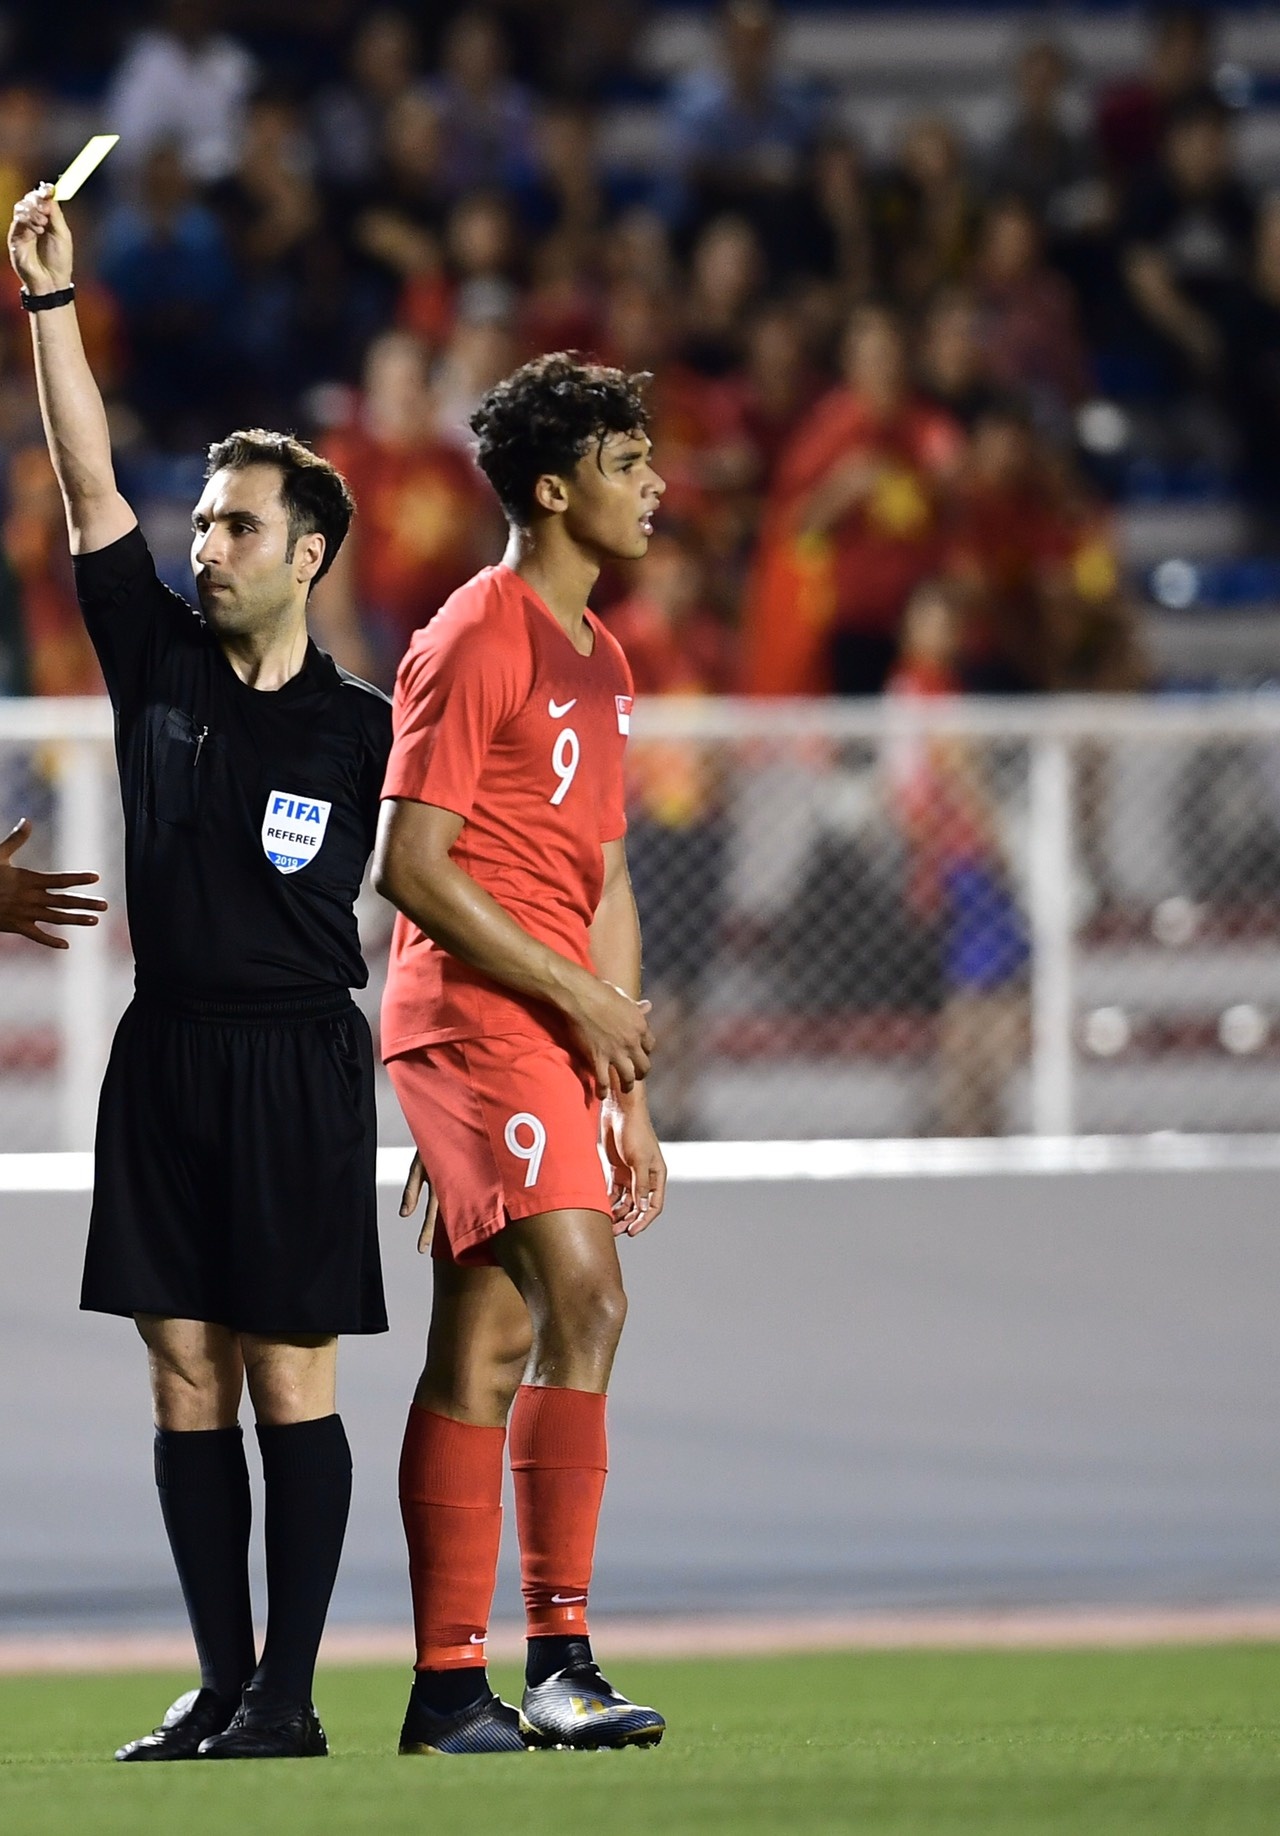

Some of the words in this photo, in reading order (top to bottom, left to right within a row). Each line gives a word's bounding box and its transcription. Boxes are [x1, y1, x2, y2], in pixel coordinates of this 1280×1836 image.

[549, 728, 580, 805] 9
[272, 797, 320, 824] FIFA
[267, 827, 317, 846] REFEREE
[274, 855, 298, 868] 2019
[504, 1112, 546, 1188] 9
